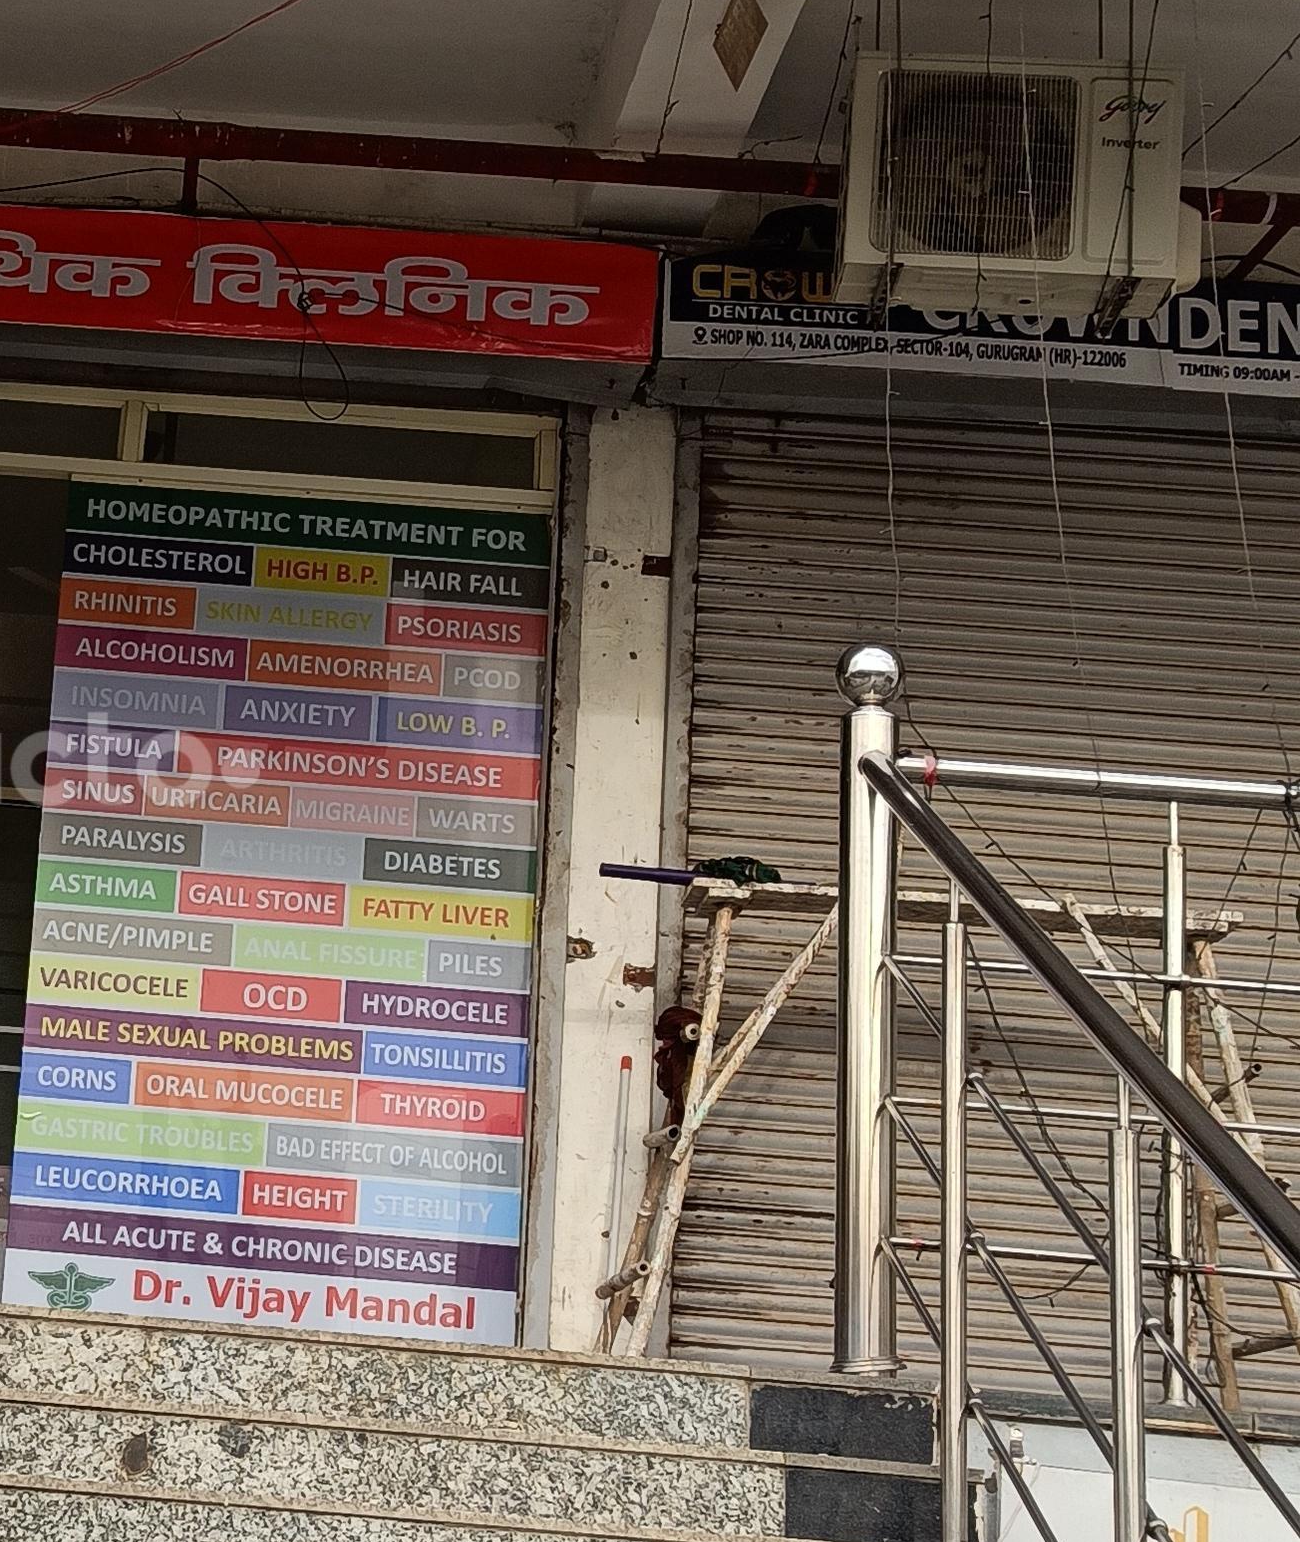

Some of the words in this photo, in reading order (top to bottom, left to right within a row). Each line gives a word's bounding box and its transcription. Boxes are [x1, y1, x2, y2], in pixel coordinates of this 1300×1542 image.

[186, 243, 601, 327] क्लिनिक
[707, 303, 786, 324] DENTAL
[788, 306, 859, 326] CLINIC
[710, 327, 743, 347] SHOP
[798, 332, 832, 352] ZARA
[1231, 365, 1292, 384] 09:00AM
[86, 498, 292, 534] HOMEOPATHIC
[298, 514, 464, 548] TREATMENT
[471, 527, 527, 552] FOR
[72, 542, 247, 576] CHOLESTEROL
[266, 558, 329, 582] HIGH
[403, 569, 462, 593] HAIR
[468, 573, 523, 597] FALL
[74, 589, 178, 618] RHINITIS
[206, 600, 263, 623] SKIN
[266, 605, 375, 632] ALLERGY
[396, 615, 522, 645] PSORIASIS
[74, 636, 236, 670] ALCOHOLISM
[255, 651, 435, 686] AMENORRHEA
[453, 665, 522, 691] PCOD
[70, 684, 207, 717] INSOMNIA
[239, 698, 357, 729] ANXIETY
[396, 711, 454, 735] LOW
[65, 733, 163, 761] FISTULA
[397, 760, 503, 790] DISEASE
[61, 777, 136, 805] SINUS
[150, 786, 283, 817] URTICARIA
[428, 808, 516, 835] WARTS
[60, 825, 186, 855] PARALYSIS
[383, 851, 501, 881] DIABETES
[49, 872, 157, 901] ASTHMA
[187, 883, 253, 908] GALL
[255, 888, 338, 915] STONE
[362, 897, 436, 924] FATTY
[441, 903, 510, 929] LIVER
[42, 919, 214, 955] ACNE/PIMPLE
[439, 952, 503, 978] PILES
[39, 965, 189, 999] VARICOCELE
[242, 982, 309, 1013] OCD
[361, 993, 510, 1026] HYDROCELE
[41, 1014, 111, 1042] MALE
[115, 1021, 212, 1051] SEXUAL
[218, 1030, 355, 1062] PROBLEMS
[36, 1064, 118, 1092] CORNS
[145, 1074, 209, 1100] ORAL
[215, 1080, 345, 1111] MUCOCELE
[379, 1092, 487, 1122] THYROID
[252, 1183, 349, 1213] HEIGHT
[61, 1220, 108, 1247] ALL
[112, 1225, 196, 1254] ACUTE
[230, 1235, 350, 1268] CHRONIC
[354, 1246, 458, 1276] DISEASE
[131, 1269, 192, 1305] Dr.
[206, 1275, 312, 1324] Vijay
[324, 1285, 476, 1331] Mandal
